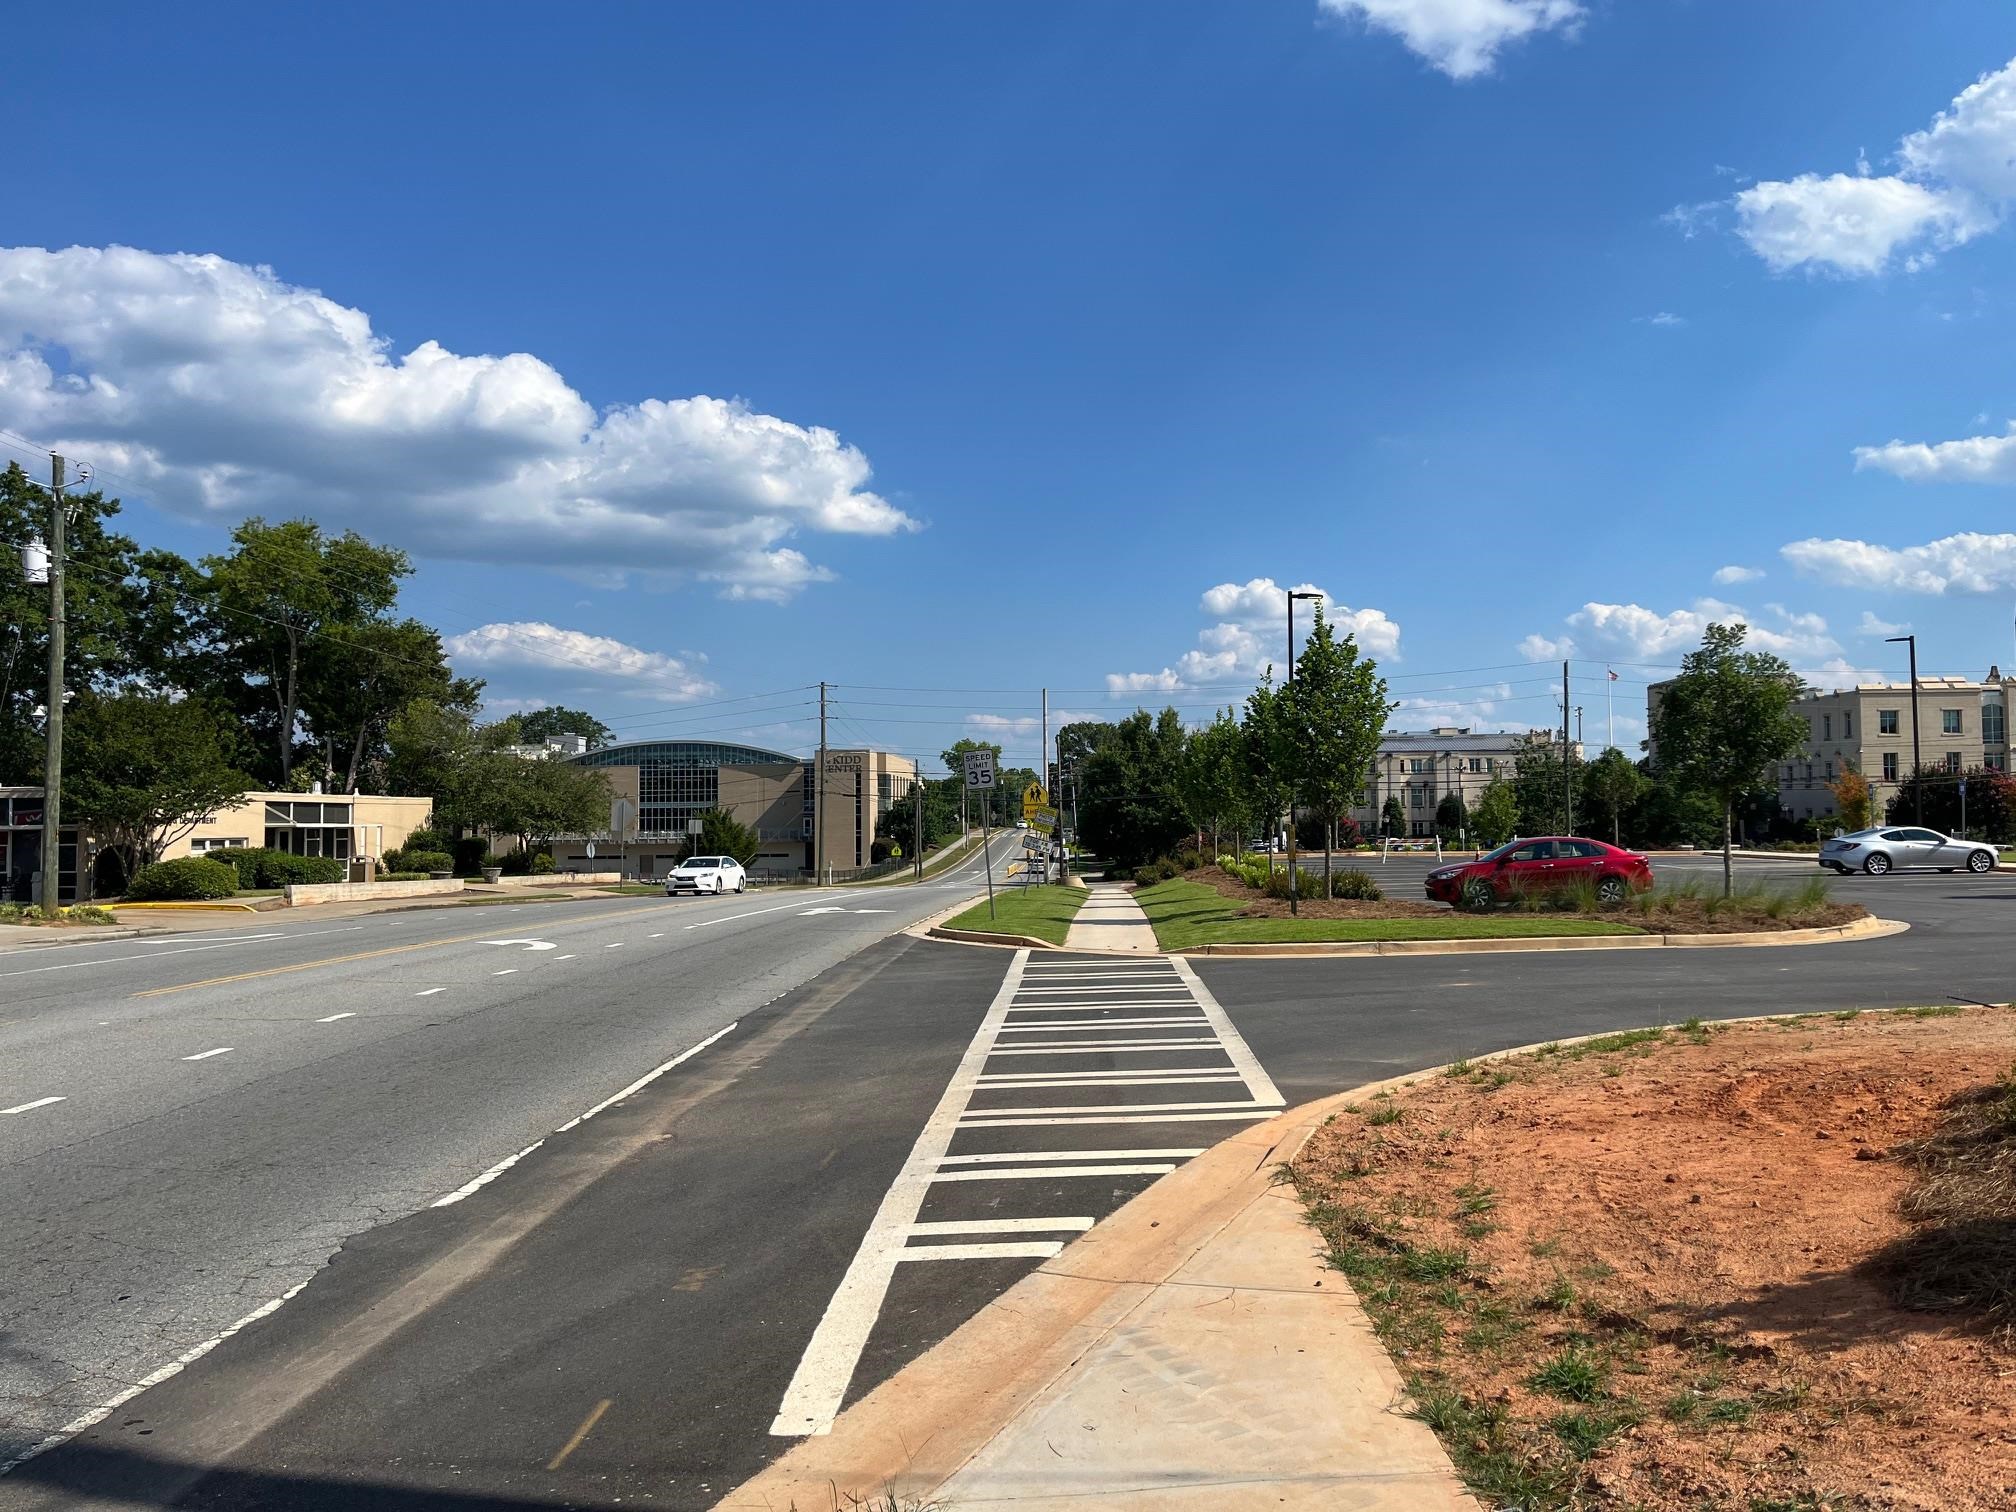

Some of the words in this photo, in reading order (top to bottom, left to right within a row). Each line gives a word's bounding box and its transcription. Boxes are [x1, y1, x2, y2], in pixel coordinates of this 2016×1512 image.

[833, 755, 862, 765] KIDD
[965, 753, 991, 762] SPEED
[968, 762, 989, 770] LIMIT
[968, 769, 992, 785] 35
